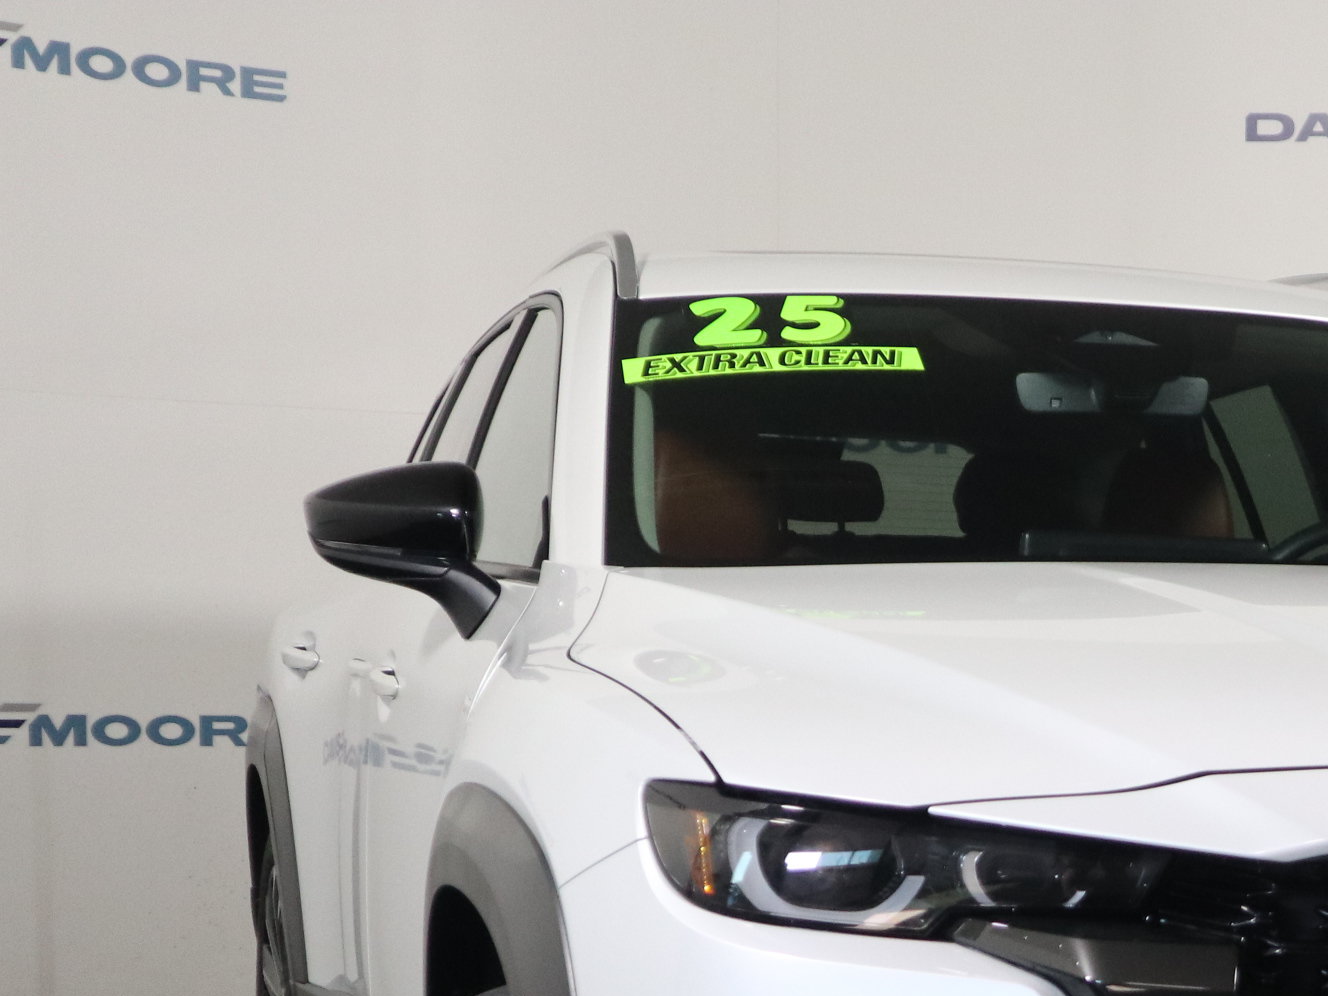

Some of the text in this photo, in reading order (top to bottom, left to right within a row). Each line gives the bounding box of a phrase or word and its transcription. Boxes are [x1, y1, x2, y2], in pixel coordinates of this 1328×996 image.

[10, 35, 287, 102] MOORE
[689, 295, 851, 347] 25
[641, 348, 901, 378] EXTRA CLEAN
[28, 714, 249, 747] MOOR
